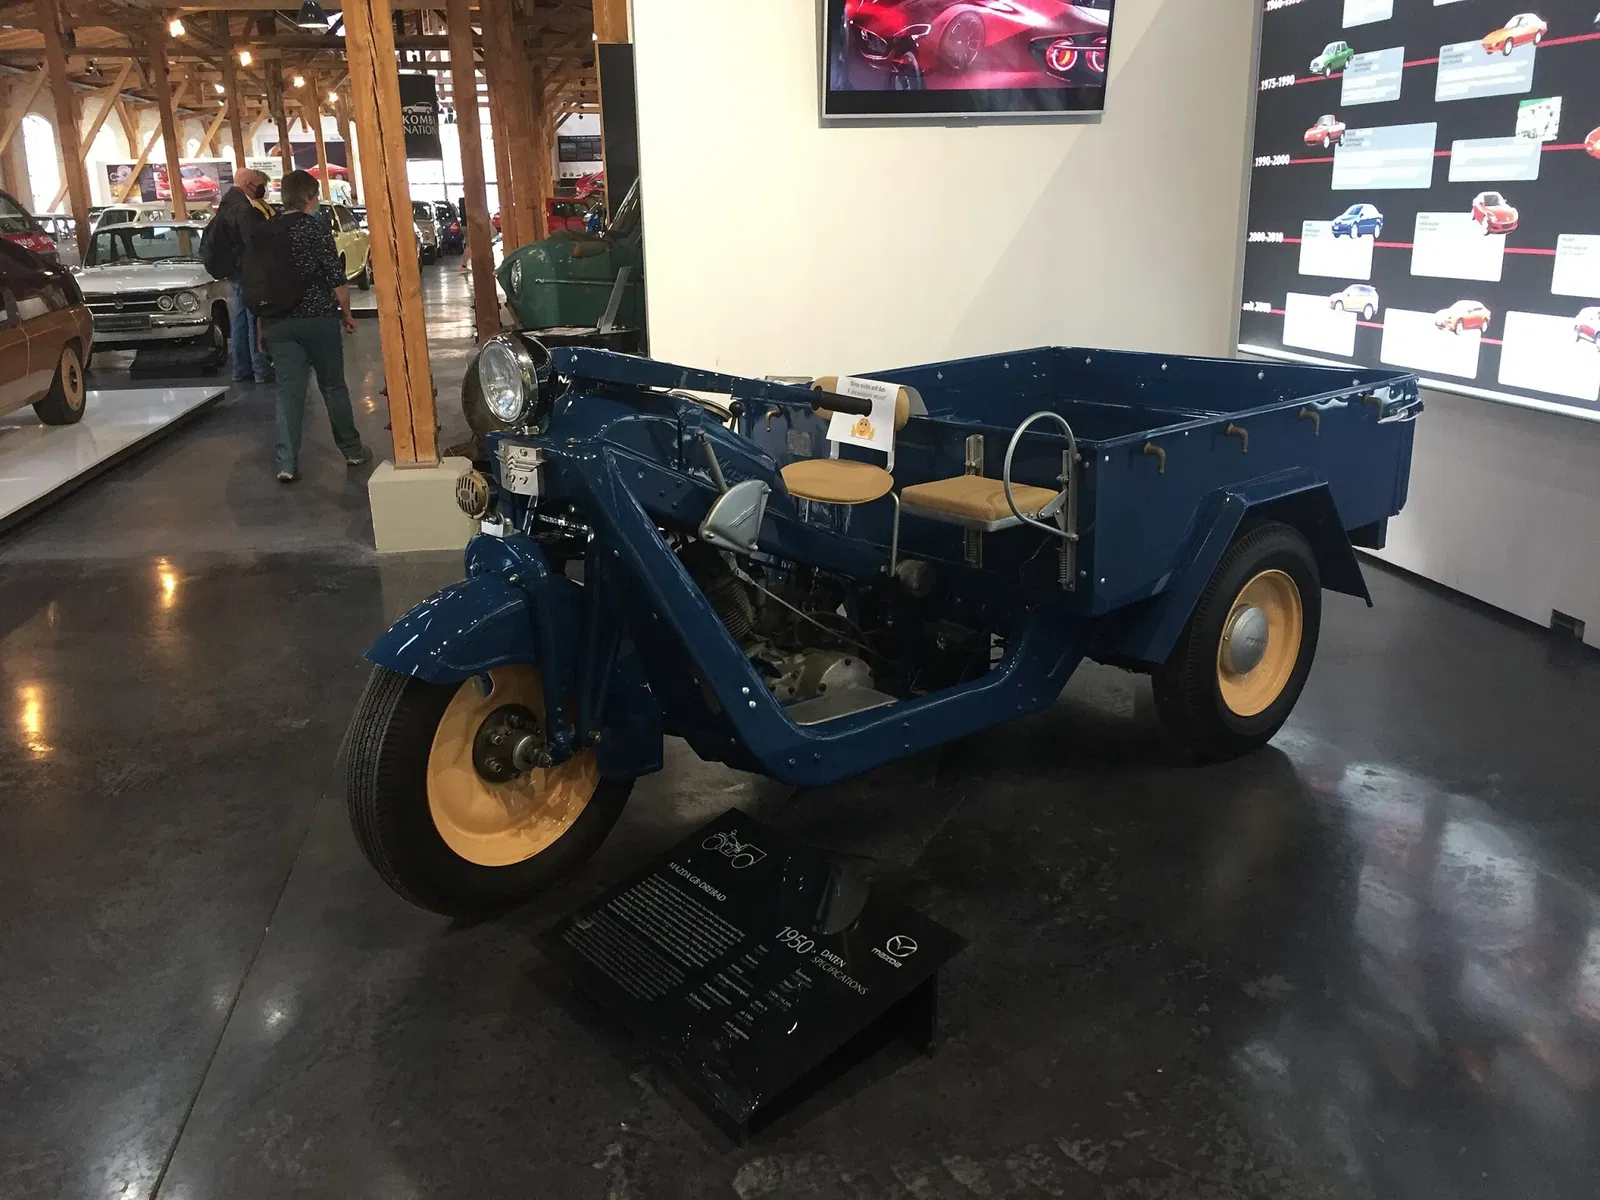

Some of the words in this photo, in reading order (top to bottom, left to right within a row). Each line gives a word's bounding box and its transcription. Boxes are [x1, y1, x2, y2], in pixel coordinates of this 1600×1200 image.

[1260, 74, 1295, 91] 1975-1990
[403, 125, 438, 135] NATION
[1255, 154, 1290, 167] 1990-2000
[668, 861, 691, 879] MAZDA
[776, 926, 815, 954] 1950
[820, 949, 846, 968] DATEN
[871, 947, 902, 968] mazda
[811, 956, 868, 995] SPECIFICATIONS
